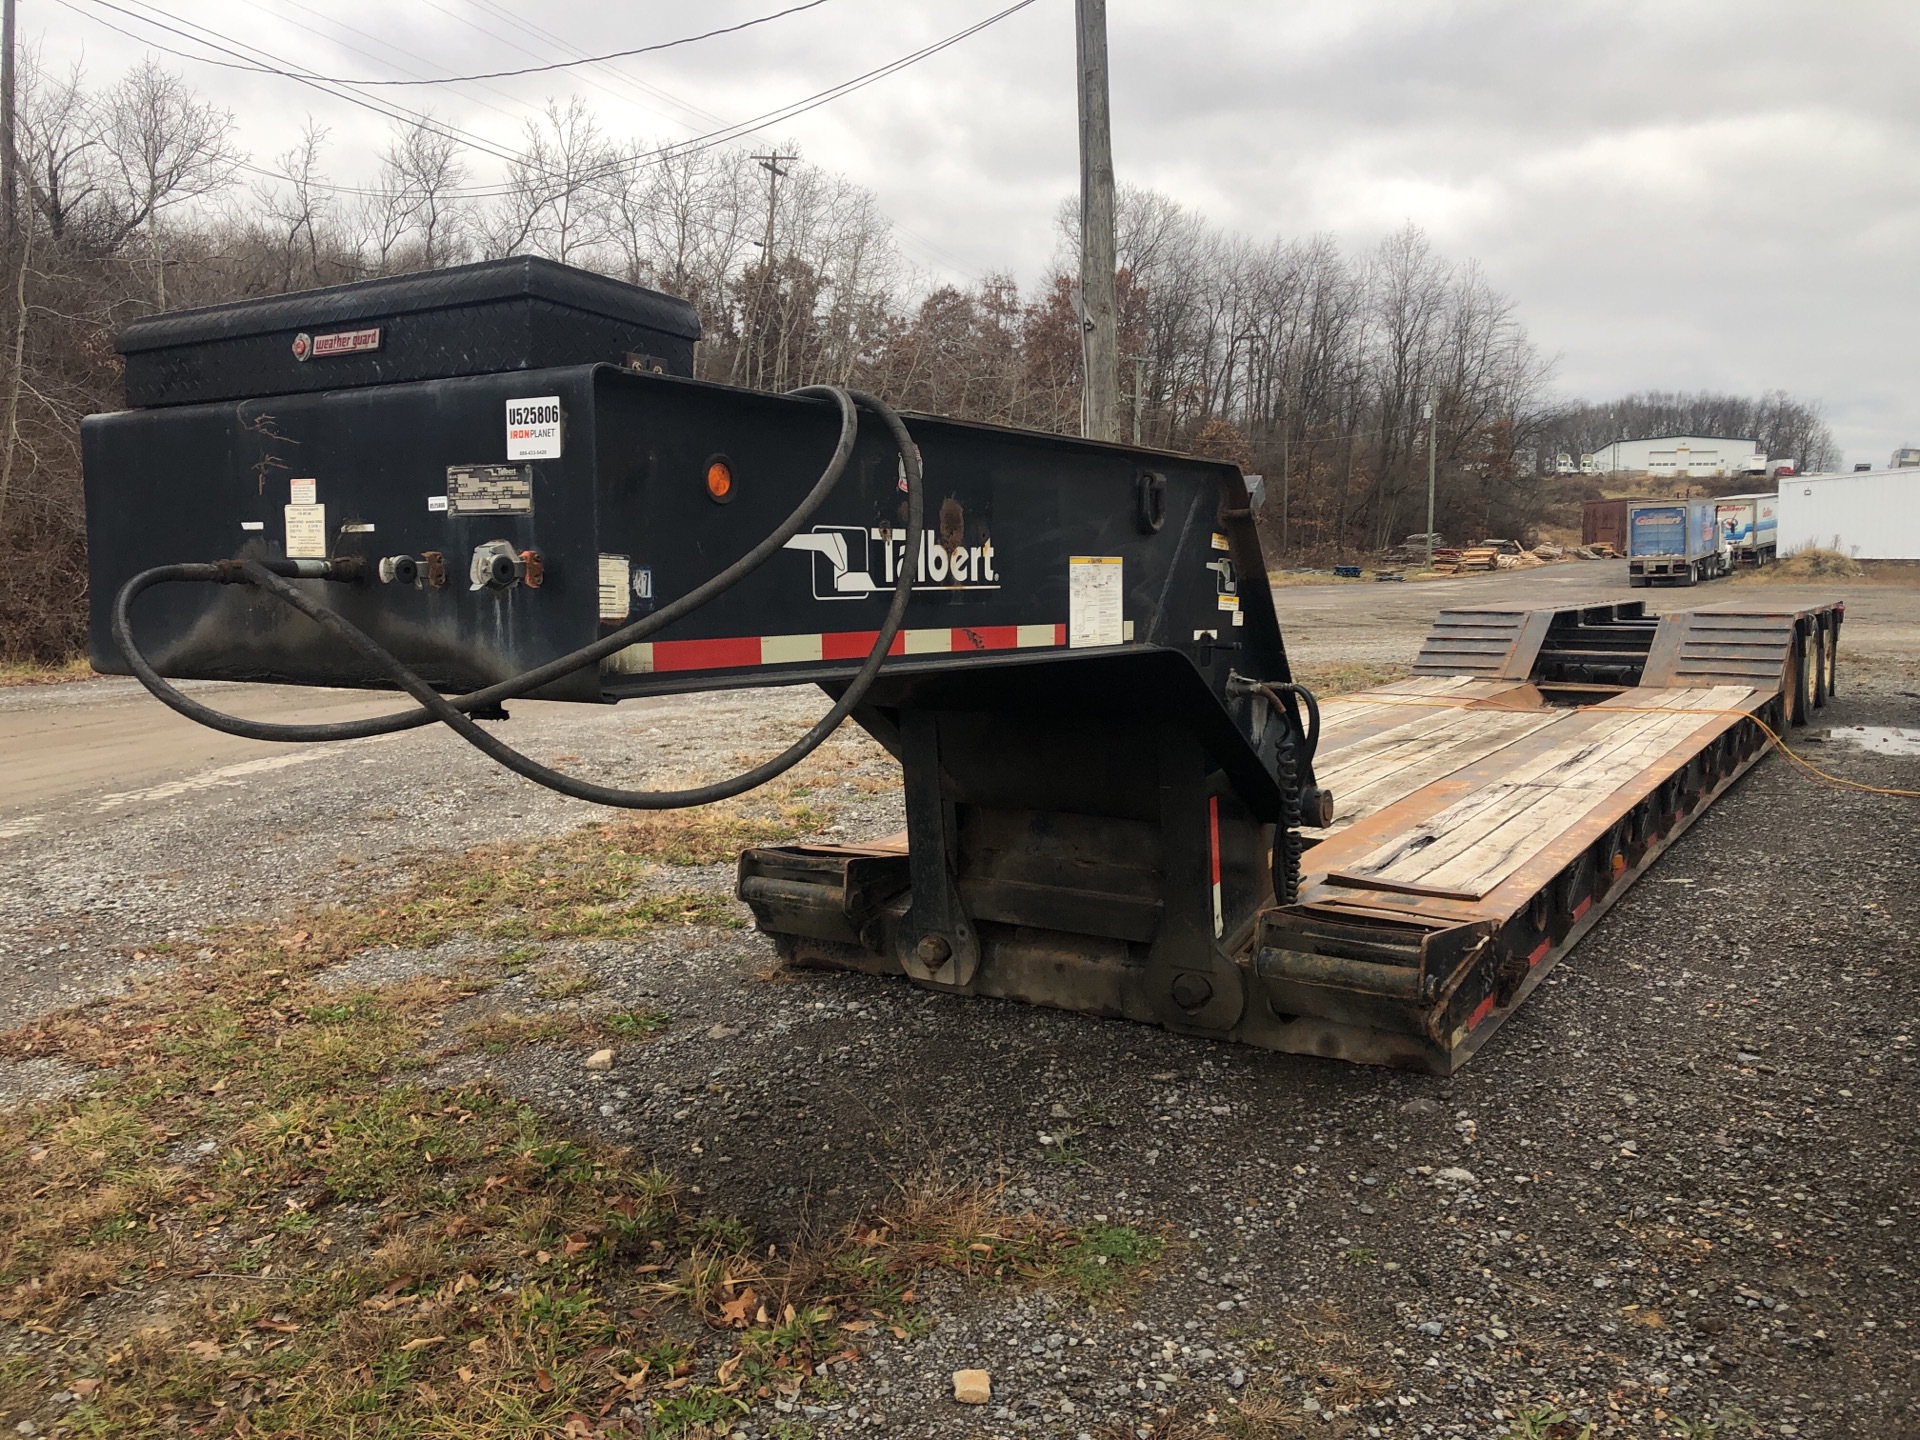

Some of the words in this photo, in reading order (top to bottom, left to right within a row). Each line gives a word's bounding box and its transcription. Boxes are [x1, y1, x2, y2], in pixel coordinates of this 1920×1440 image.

[315, 335, 351, 350] weather
[352, 330, 376, 349] guard
[509, 405, 558, 425] U525806
[510, 429, 555, 439] IRONPLANET
